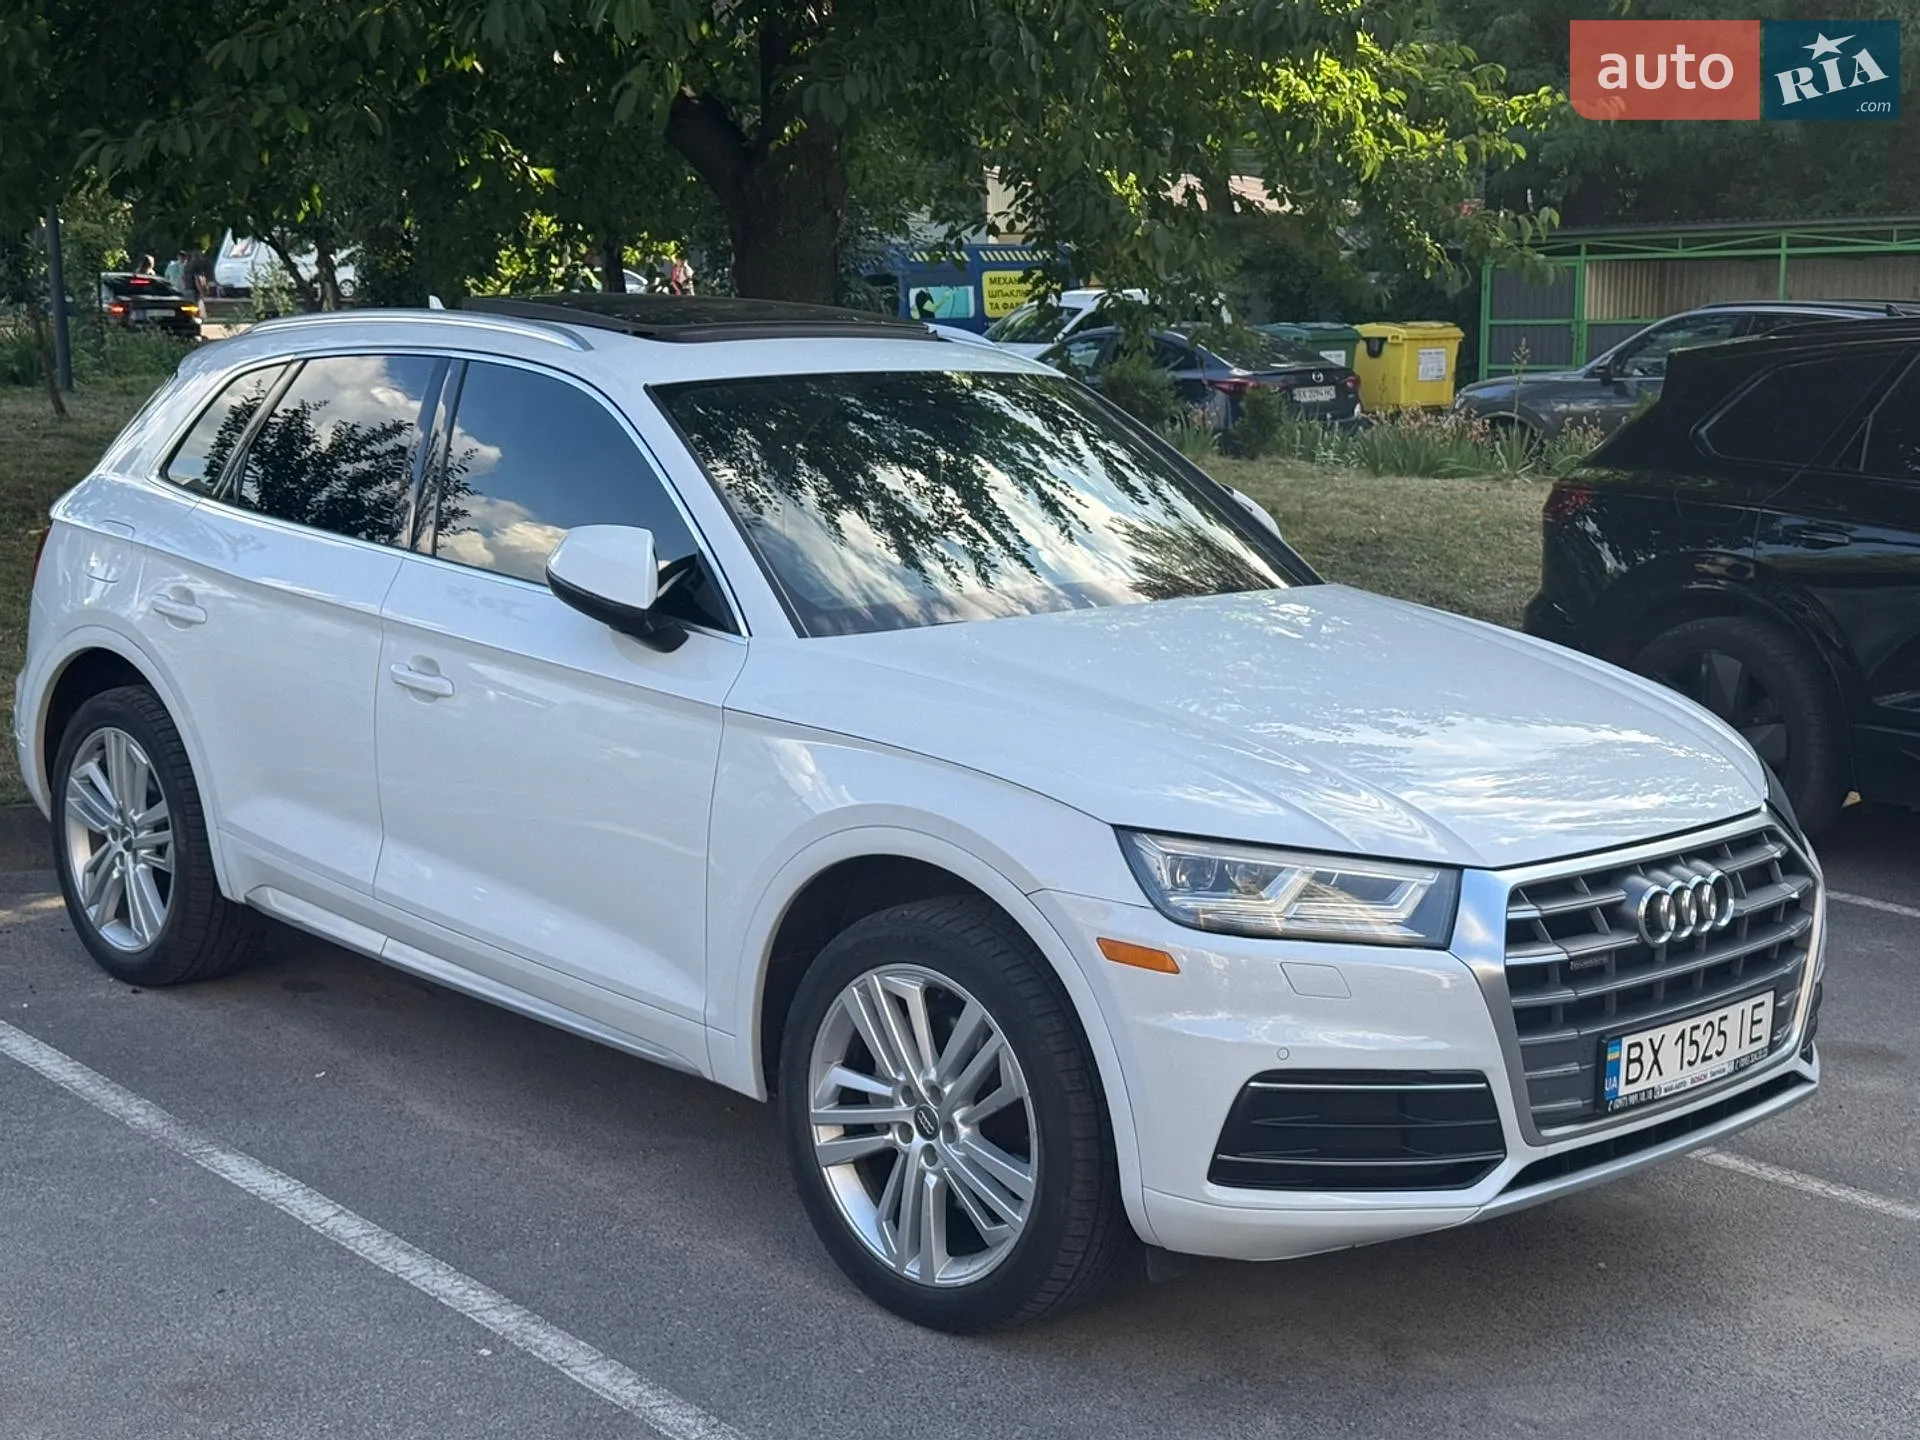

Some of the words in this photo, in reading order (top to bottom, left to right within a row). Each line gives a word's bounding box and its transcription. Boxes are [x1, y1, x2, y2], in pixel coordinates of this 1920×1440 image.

[989, 302, 1000, 311] ТА
[1625, 1034, 1665, 1086] BX
[1674, 1014, 1728, 1071] 1525
[1738, 1001, 1765, 1049] IE
[1604, 1076, 1618, 1091] UA
